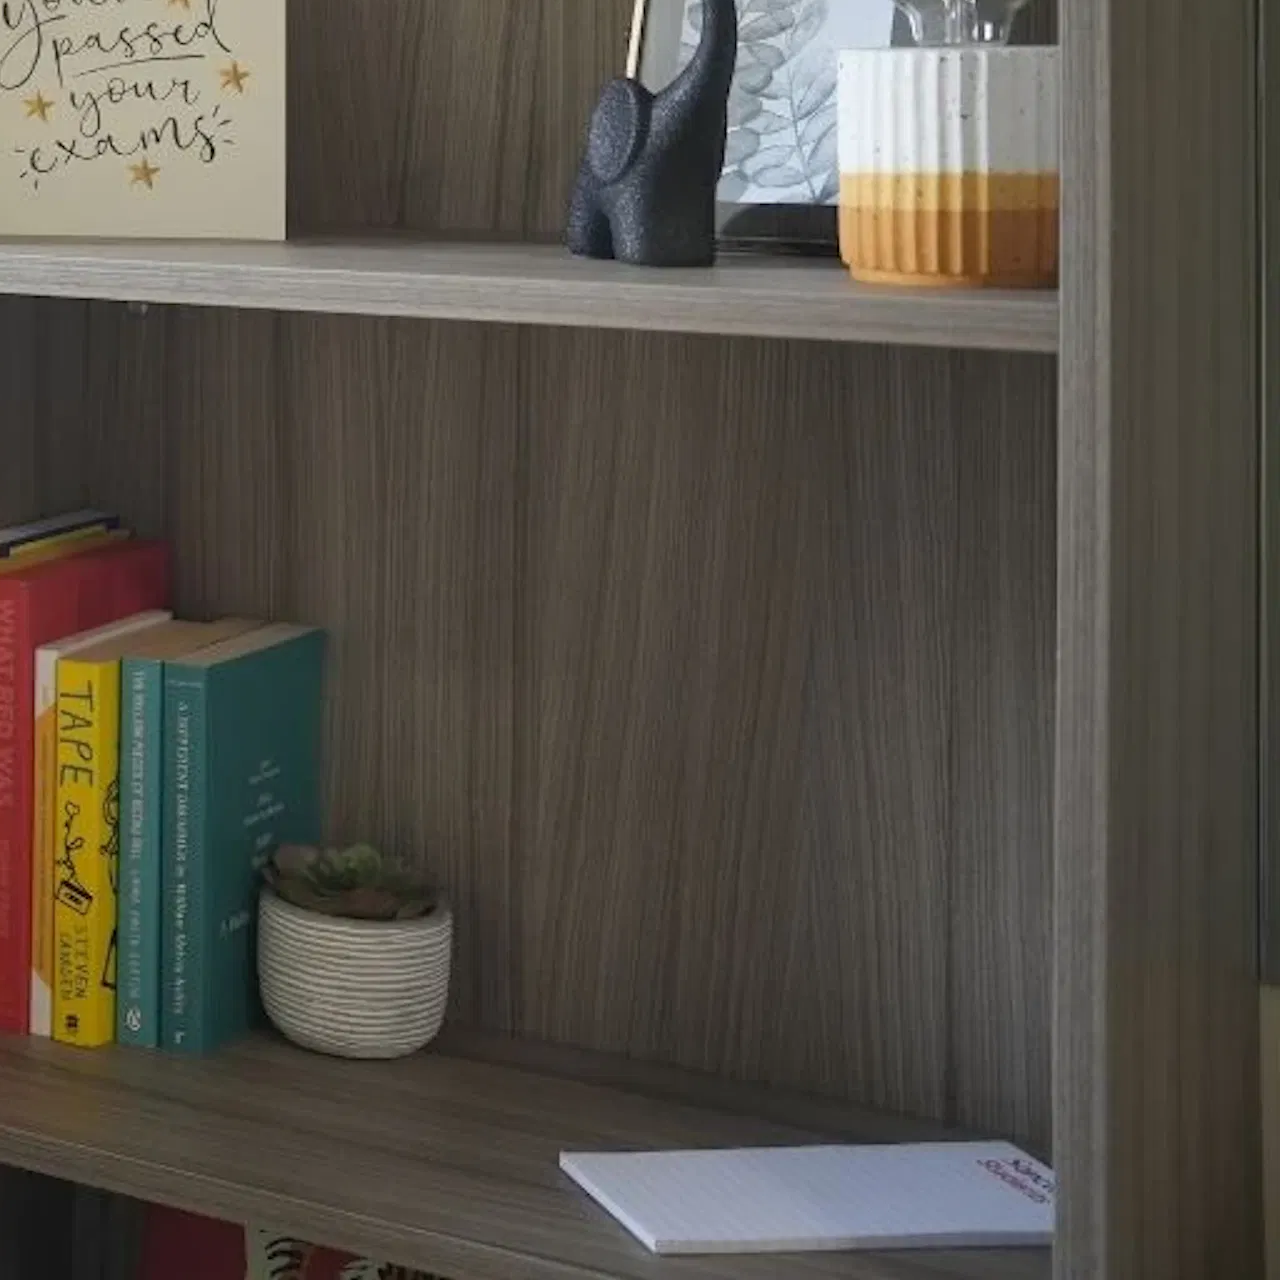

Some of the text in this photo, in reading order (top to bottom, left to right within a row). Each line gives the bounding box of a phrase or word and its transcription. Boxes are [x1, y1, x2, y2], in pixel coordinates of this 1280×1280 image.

[69, 74, 202, 139] your
[29, 114, 216, 173] exams
[59, 679, 95, 789] TAPE
[73, 923, 91, 1001] STEVEN
